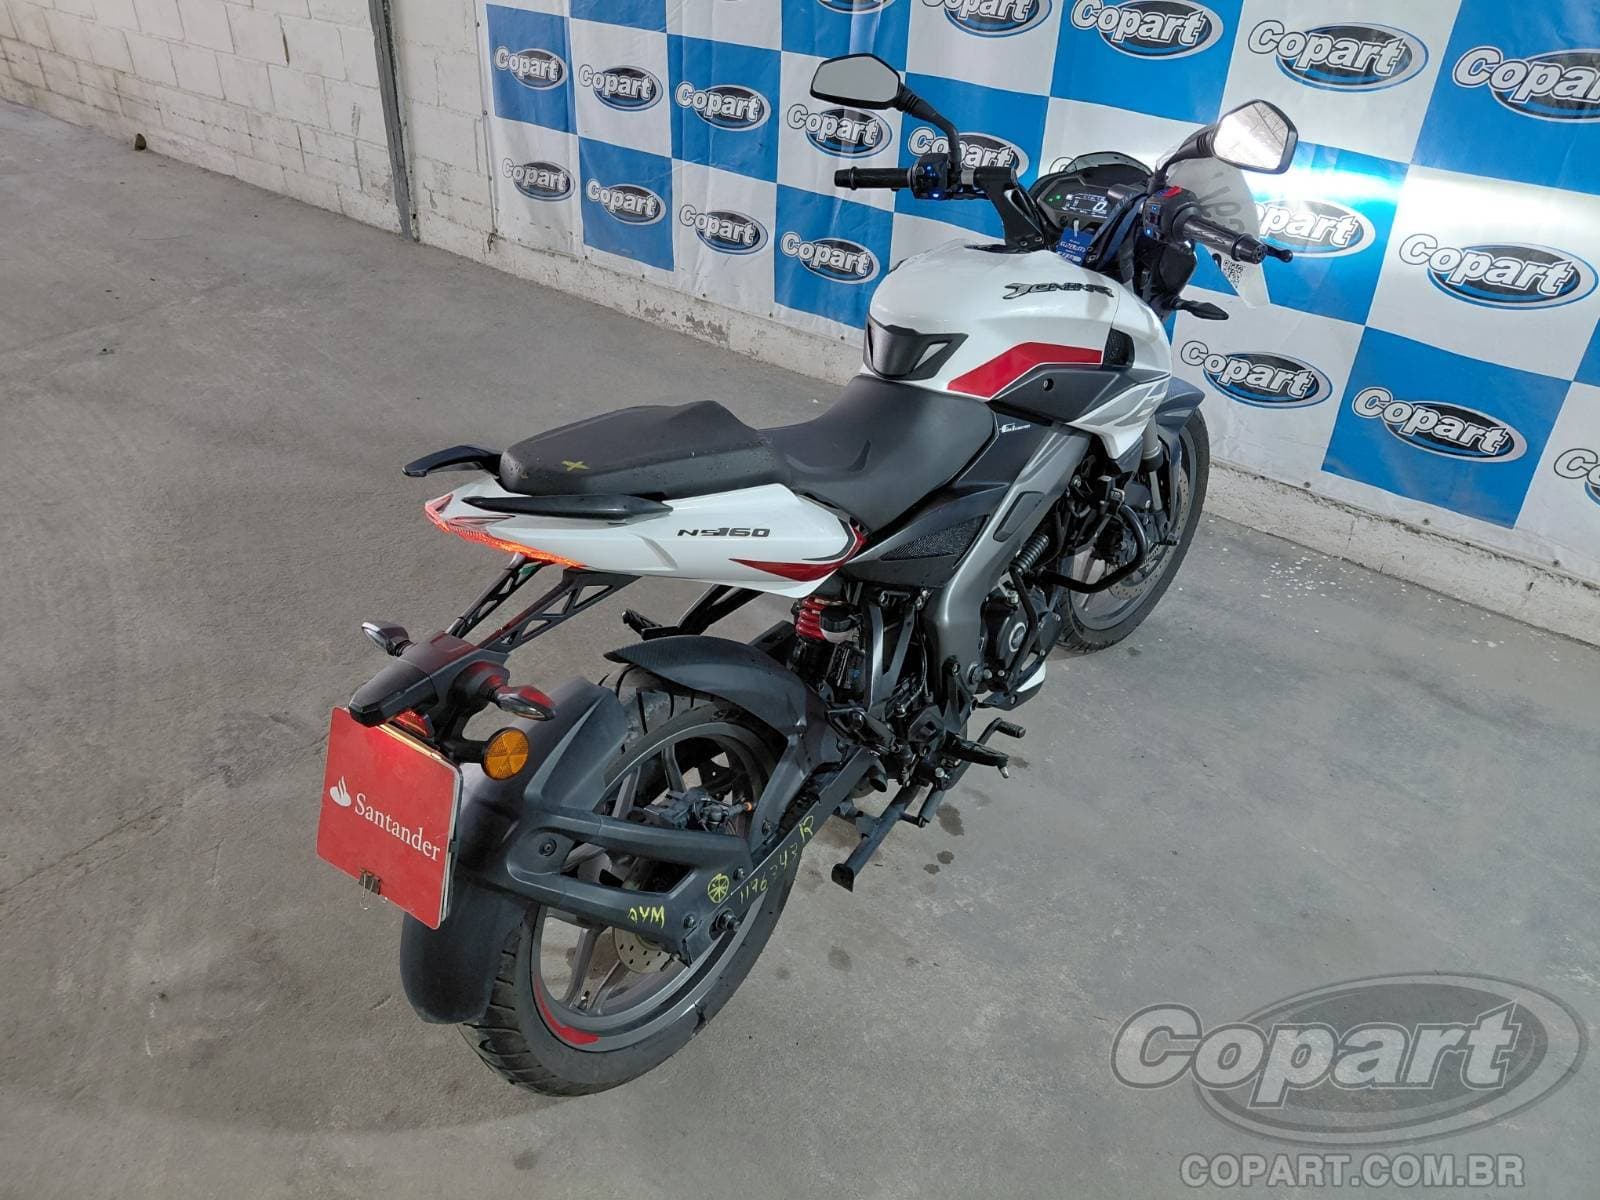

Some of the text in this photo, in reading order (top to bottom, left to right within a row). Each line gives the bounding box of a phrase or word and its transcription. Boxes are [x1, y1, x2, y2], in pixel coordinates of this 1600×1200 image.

[922, 0, 1034, 22] part
[1071, 0, 1208, 46] Copart
[495, 46, 559, 81] Copart
[1248, 20, 1408, 76] Copart
[579, 64, 653, 100] Copart
[675, 81, 760, 122] Copart
[787, 104, 881, 145] Copart
[502, 158, 568, 192] Copart
[586, 179, 658, 219] Copart
[679, 205, 757, 247] Copart
[781, 232, 871, 276] Copart
[1399, 234, 1577, 296] Copart
[1180, 340, 1316, 397] Copart
[1352, 387, 1511, 456] Copart
[677, 527, 771, 538] NS160
[355, 793, 440, 861] Santander
